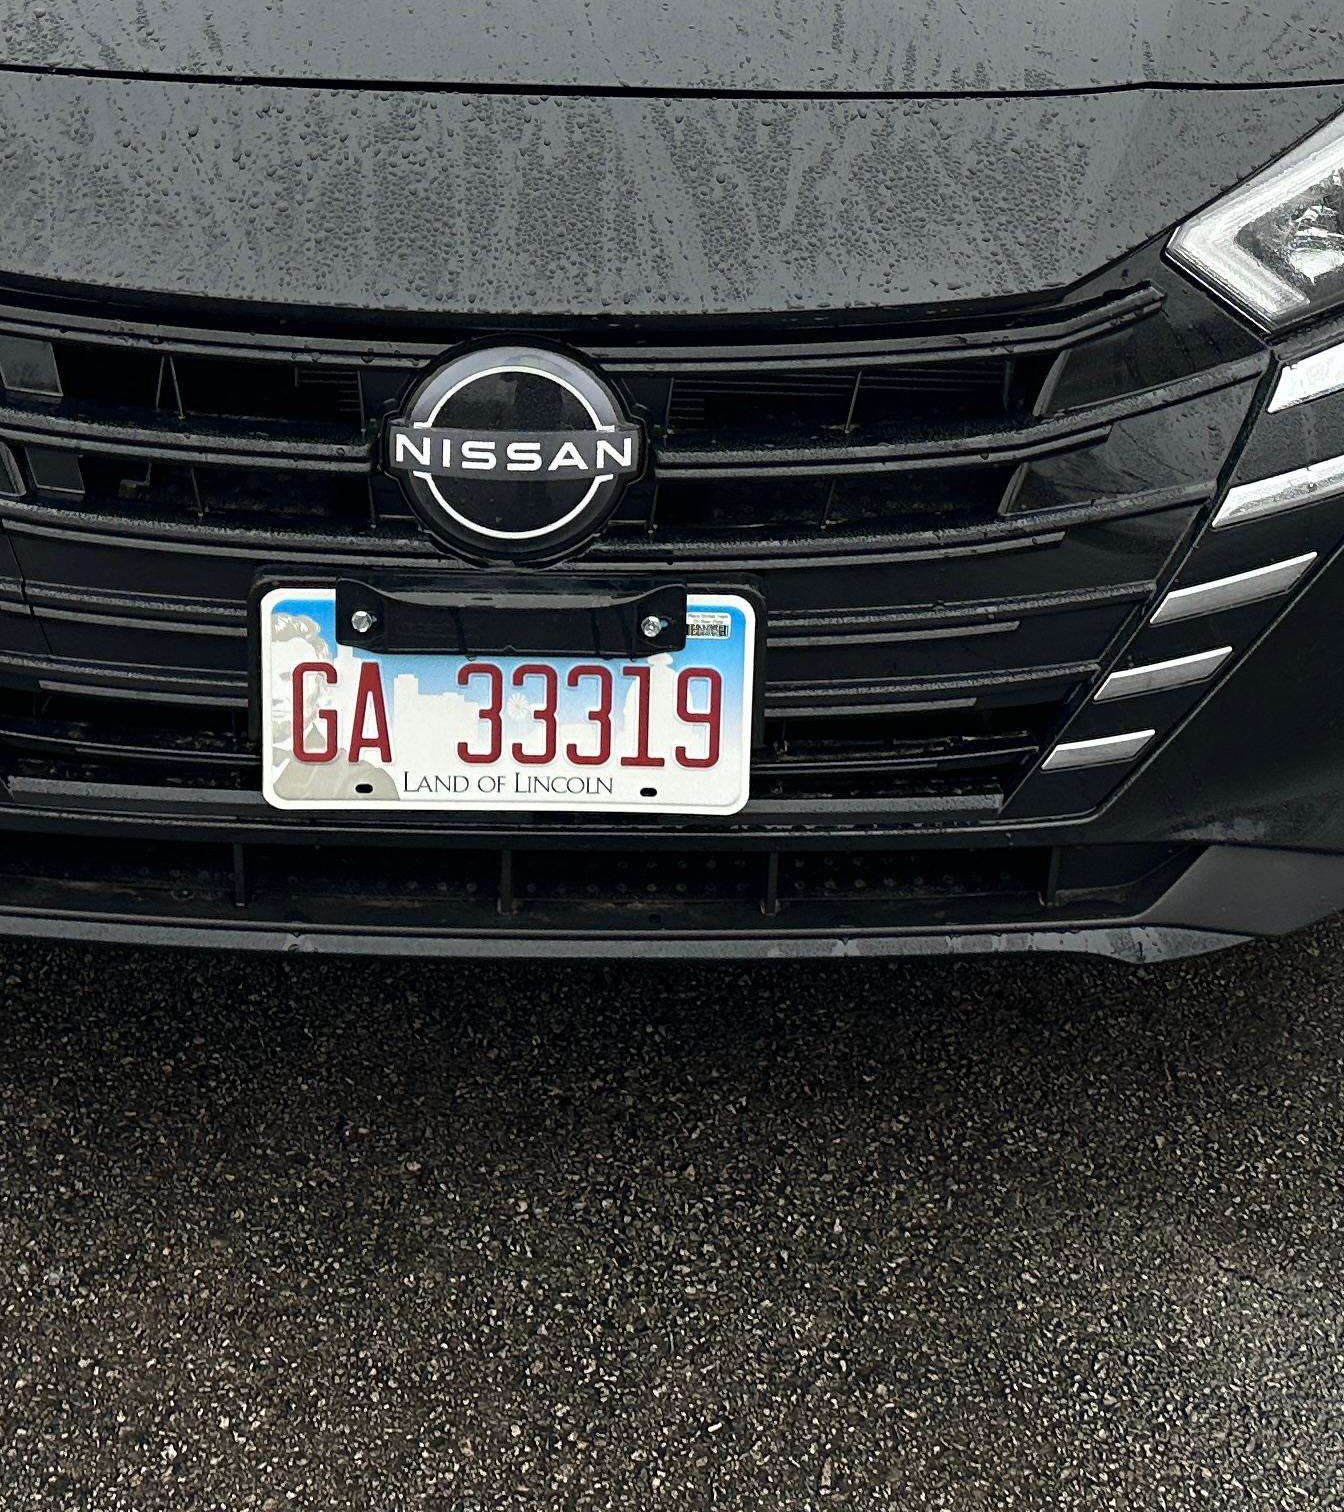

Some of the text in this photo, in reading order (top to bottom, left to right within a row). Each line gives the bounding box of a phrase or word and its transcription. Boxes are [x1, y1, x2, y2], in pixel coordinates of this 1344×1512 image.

[395, 433, 632, 471] NISSAN
[291, 661, 723, 769] GA 33319
